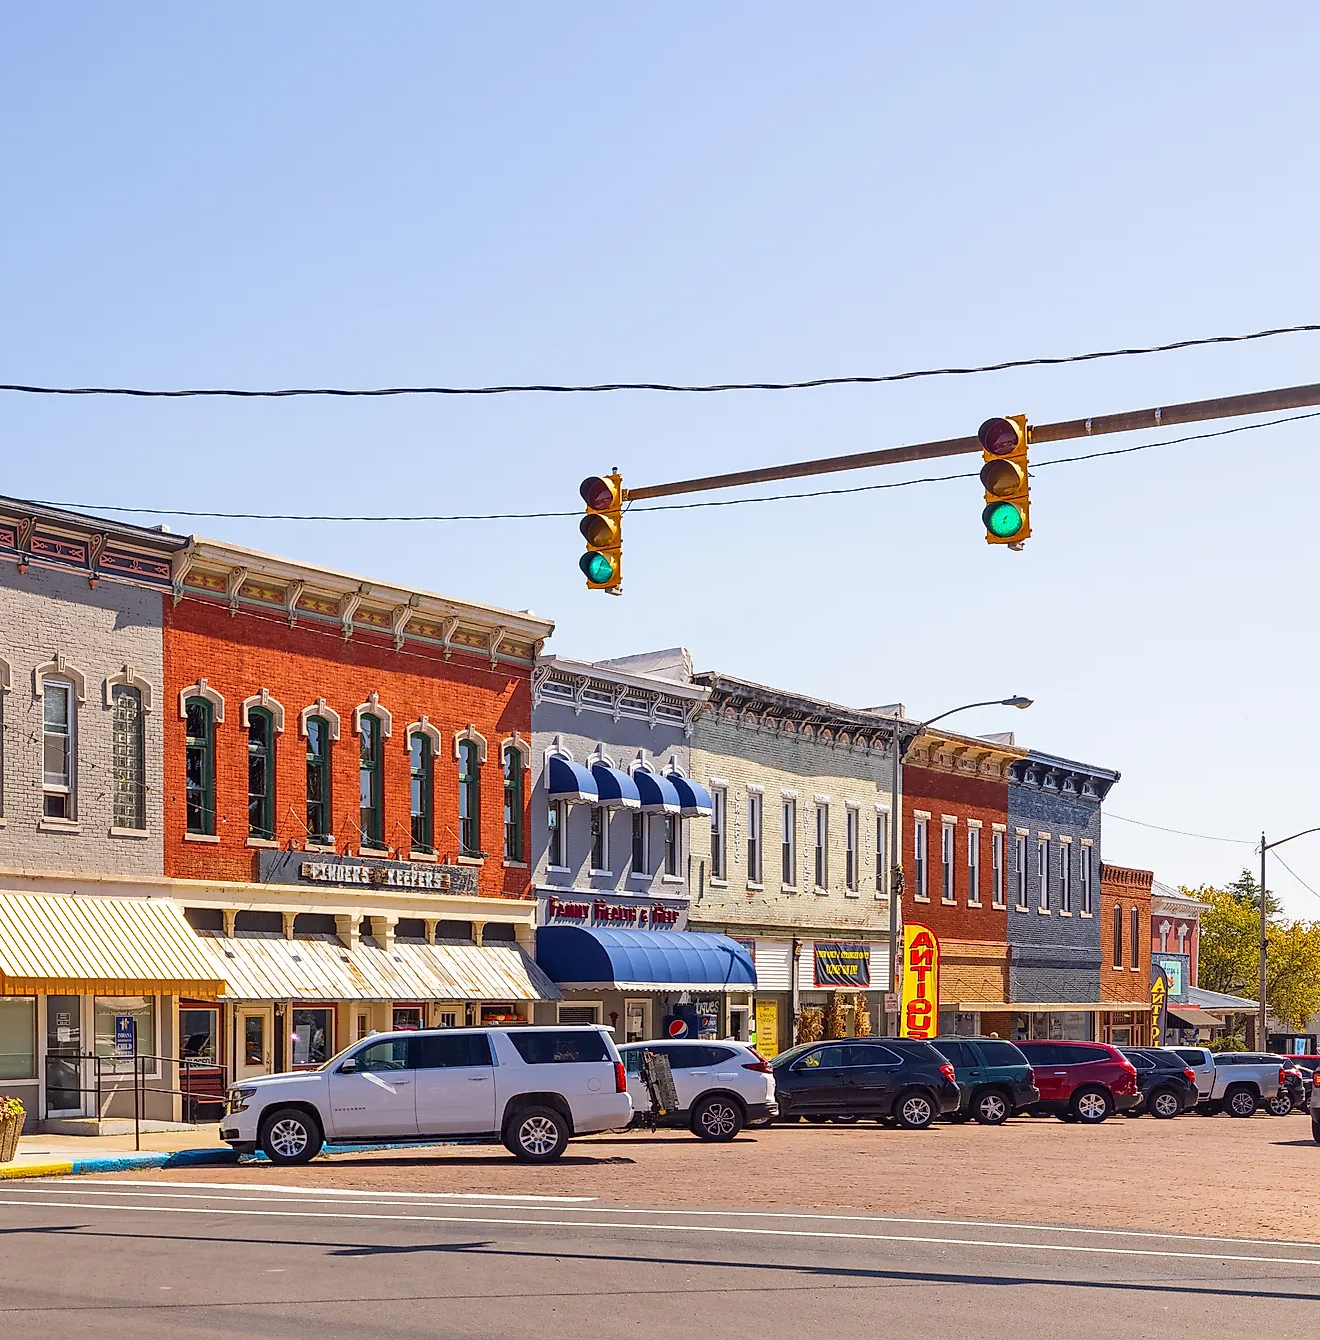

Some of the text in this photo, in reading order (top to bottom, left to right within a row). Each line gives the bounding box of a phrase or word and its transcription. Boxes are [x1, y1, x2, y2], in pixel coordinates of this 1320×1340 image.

[311, 862, 442, 888] FINDERS KEEPERS
[549, 896, 590, 918] FAMILY
[594, 899, 637, 921] HEALTH
[826, 964, 841, 974] COME
